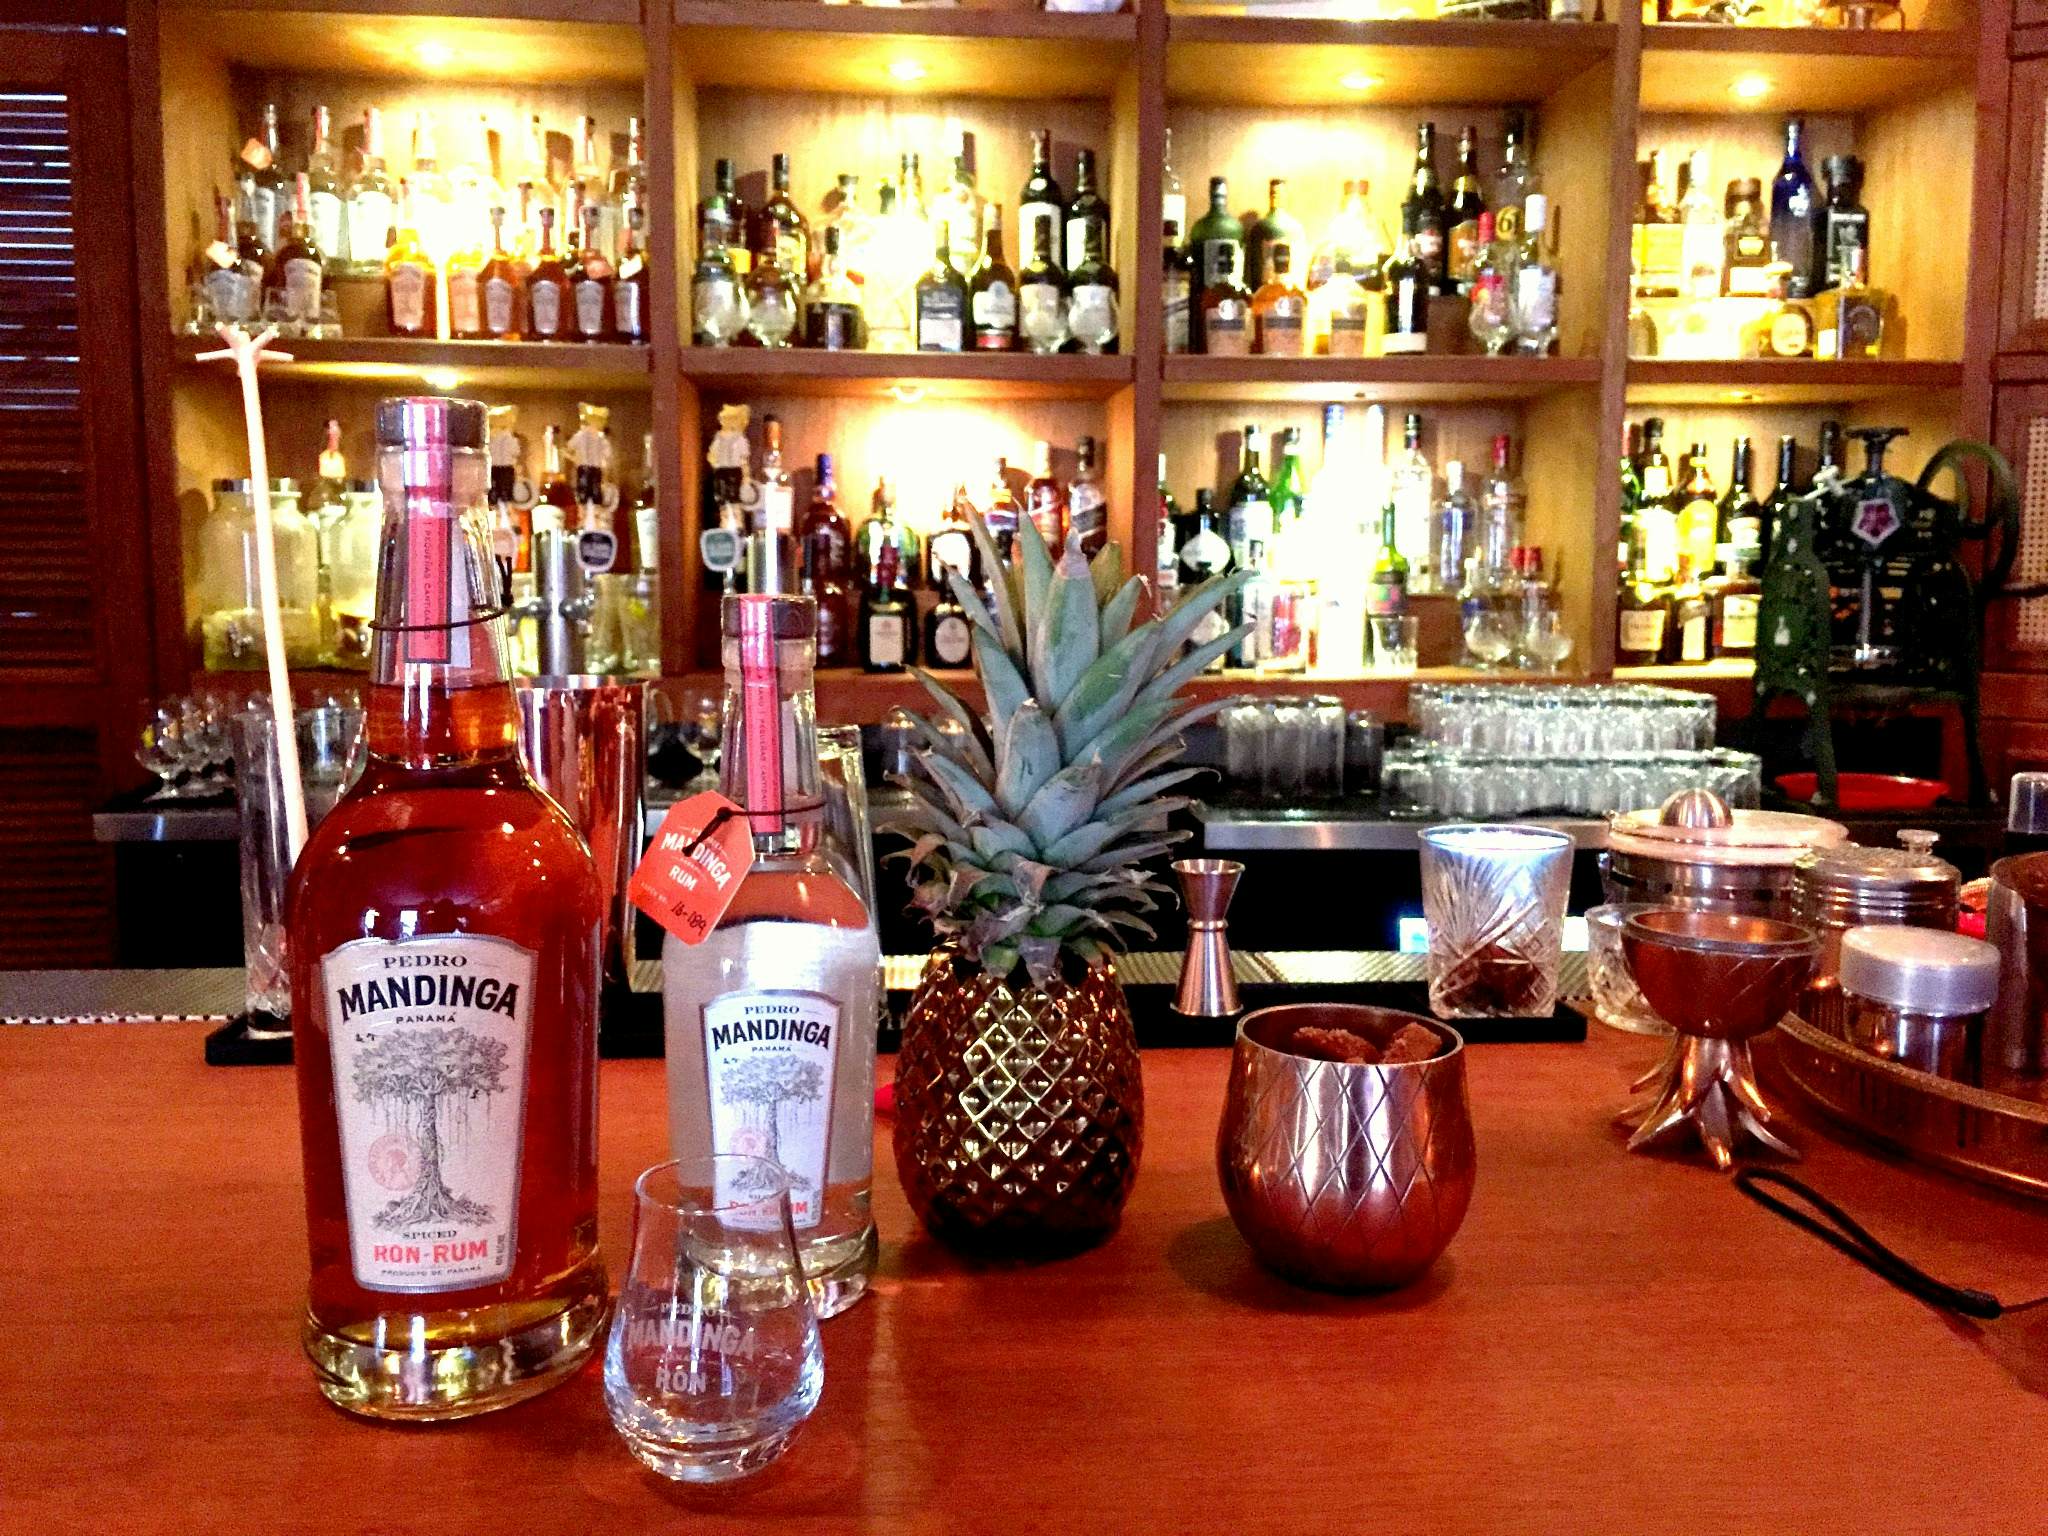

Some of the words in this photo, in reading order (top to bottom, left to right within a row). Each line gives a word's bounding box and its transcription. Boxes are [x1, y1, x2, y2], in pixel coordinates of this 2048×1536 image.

[669, 865, 697, 891] RUM
[384, 955, 468, 969] PEDRO
[336, 974, 519, 1025] MANDINGA
[744, 1005, 800, 1014] PEDRO
[396, 1012, 456, 1024] PANAMÁ
[711, 1018, 831, 1051] MANDINGA
[402, 1230, 457, 1239] SPICED
[655, 1366, 707, 1394] RON
